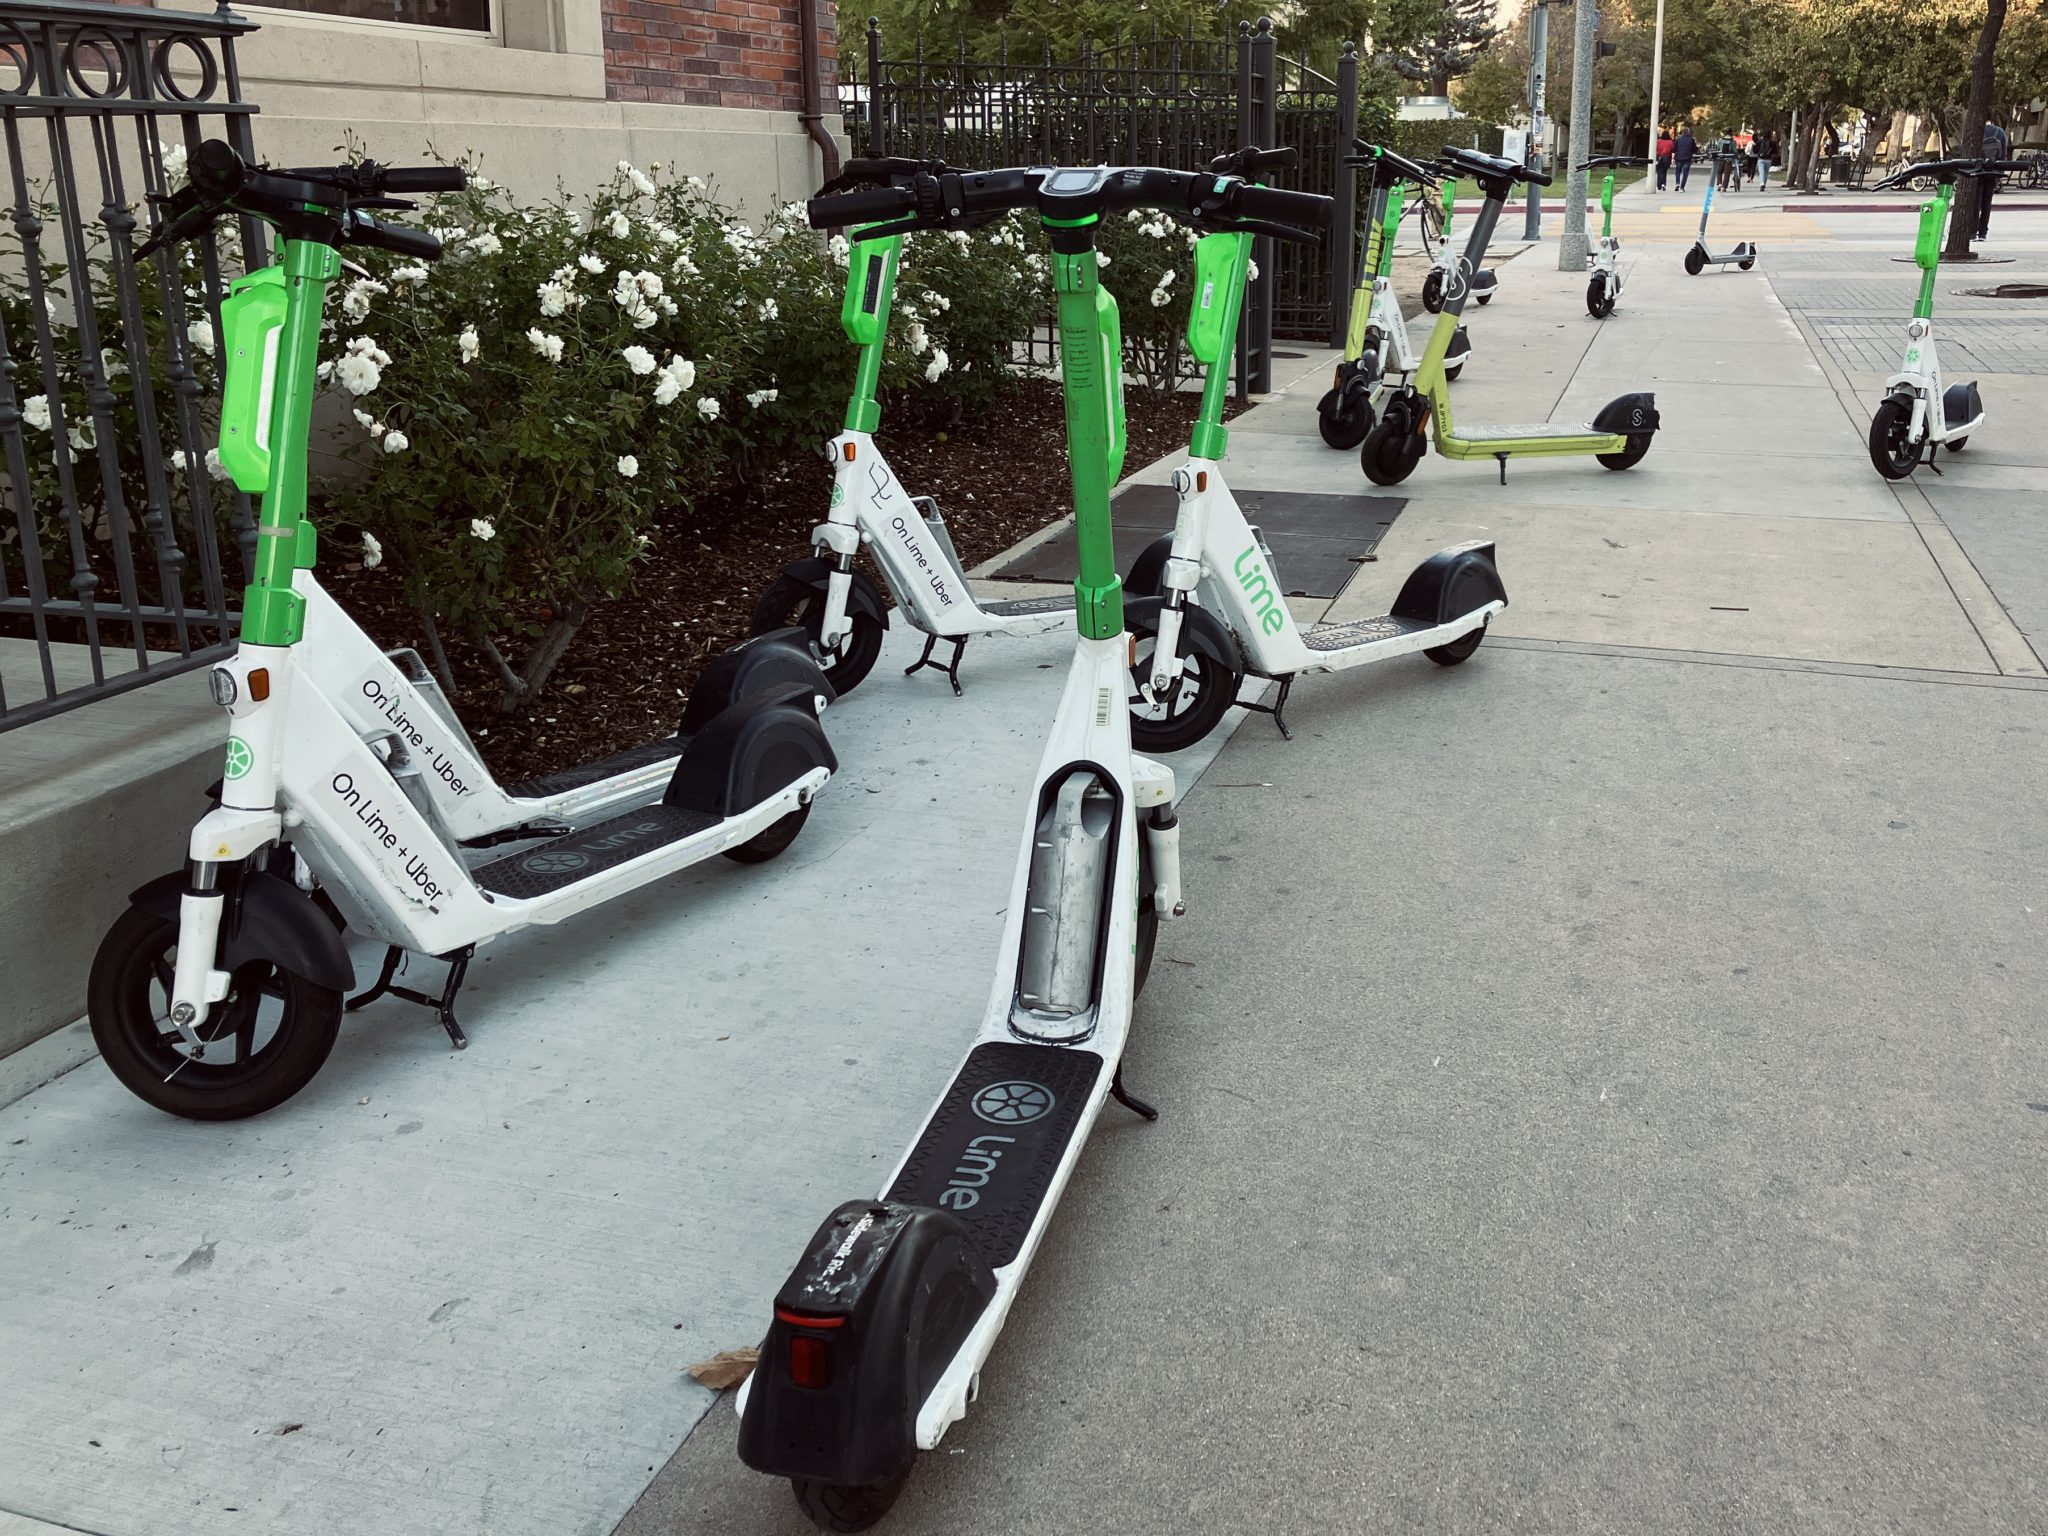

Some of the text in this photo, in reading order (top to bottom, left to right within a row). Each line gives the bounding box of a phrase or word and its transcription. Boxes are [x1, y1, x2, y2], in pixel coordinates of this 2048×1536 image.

[892, 517, 953, 606] On Lime + Uber
[1234, 545, 1284, 636] Lime
[362, 680, 469, 796] On Lime + Uber
[332, 773, 443, 902] On Lime + Uber
[582, 822, 664, 850] Lime
[939, 1135, 1016, 1210] Lime
[834, 1217, 874, 1259] Sidewalk
